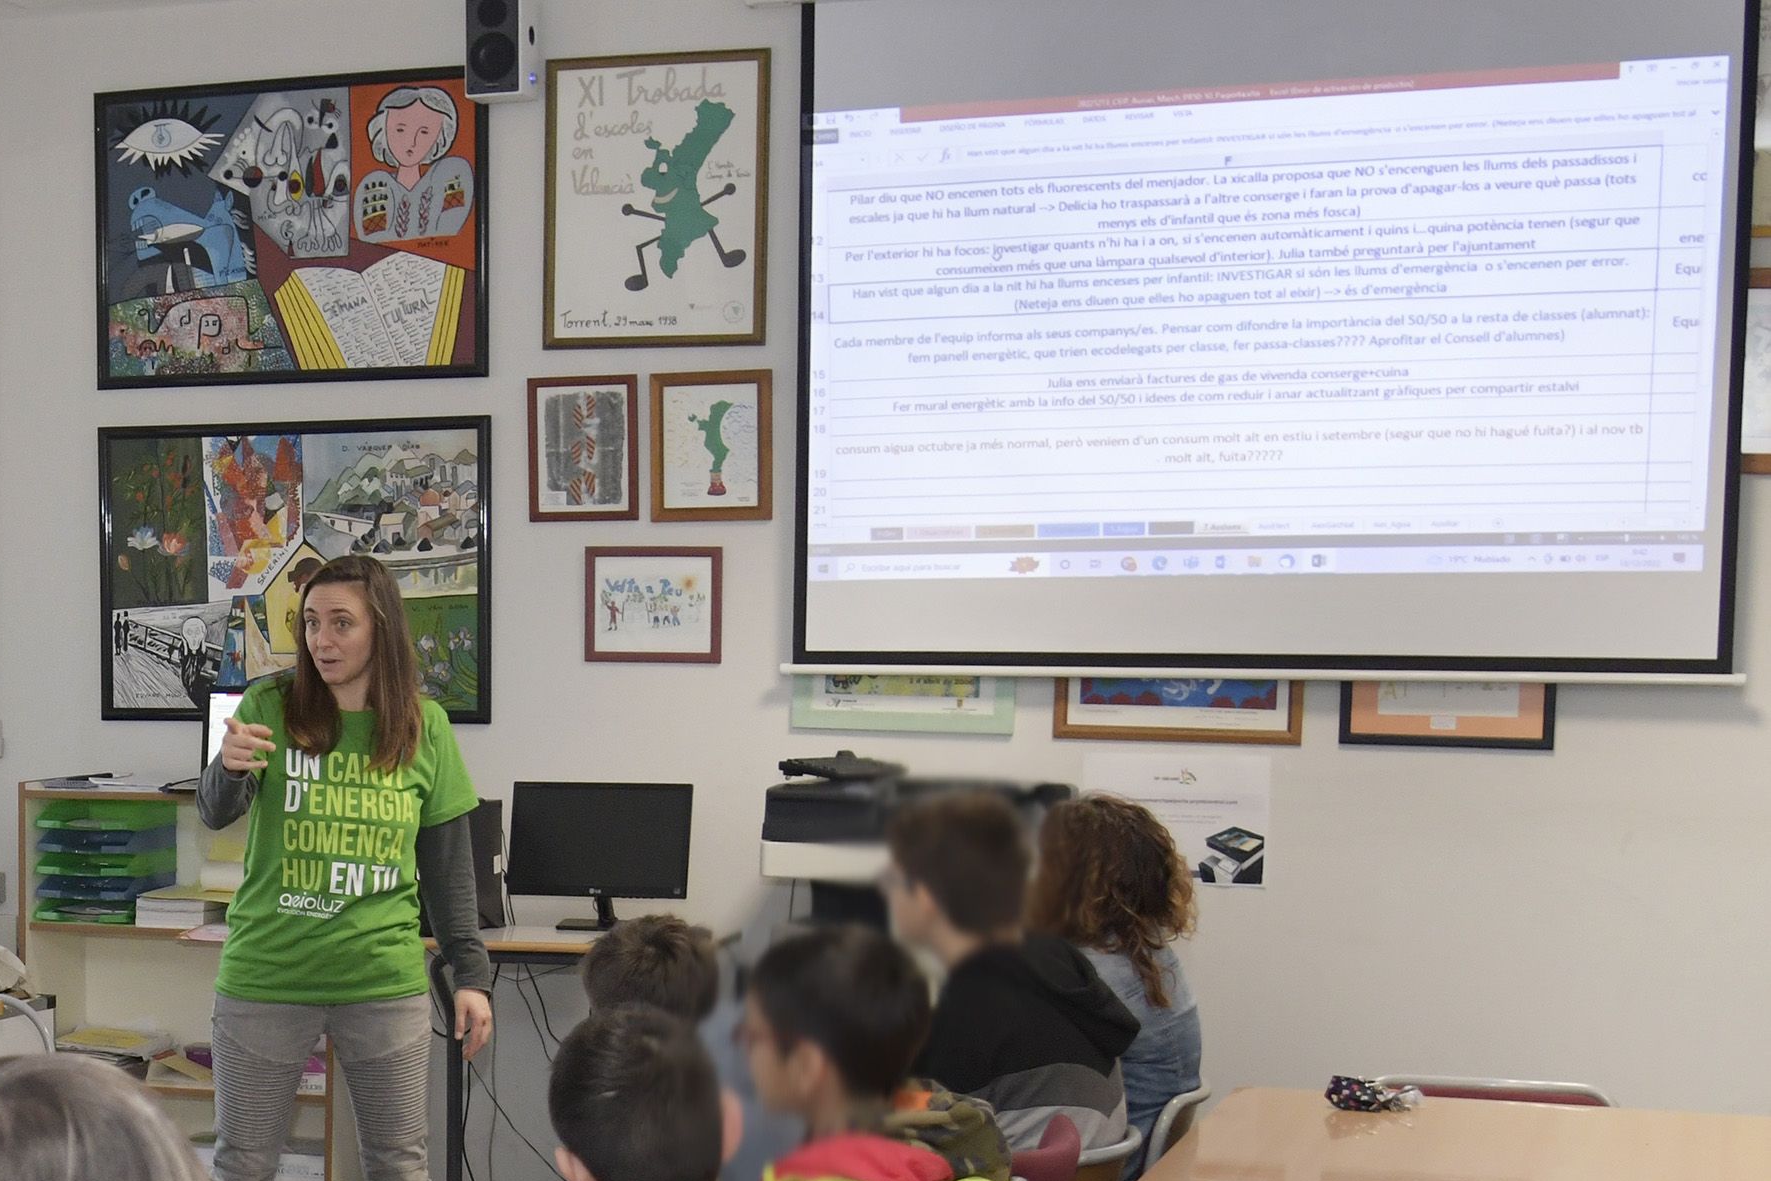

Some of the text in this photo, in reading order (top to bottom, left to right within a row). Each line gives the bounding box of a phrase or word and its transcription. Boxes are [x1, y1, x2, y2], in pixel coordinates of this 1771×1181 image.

[577, 67, 727, 107] XI Trobada
[573, 146, 594, 161] en
[850, 193, 875, 204] Pilar
[878, 191, 897, 203] diu
[899, 192, 922, 204] que
[925, 189, 945, 200] NO
[947, 188, 998, 199] encenen
[1000, 185, 1025, 196] tots
[1027, 183, 1044, 194] els
[1047, 179, 1121, 193] fluorescents
[1124, 178, 1143, 189] del
[1213, 173, 1227, 184] La
[1272, 171, 1324, 184] proposa
[1326, 169, 1351, 181] que
[1354, 166, 1375, 177] NO
[1462, 160, 1480, 172] les
[1483, 159, 1518, 170] llums
[1521, 157, 1548, 169] dels
[1551, 153, 1629, 170] passadissos
[849, 211, 890, 223] escales
[893, 210, 904, 223] ja
[906, 211, 929, 223] que
[932, 207, 943, 218] hi
[946, 206, 961, 218] ha
[963, 205, 989, 217] llum
[992, 202, 1036, 215] natural
[1101, 198, 1117, 209] ho
[1119, 194, 1190, 211] traspassarà
[1242, 191, 1300, 204] conserge
[1309, 187, 1343, 198] faran
[1346, 186, 1357, 197] la
[1360, 186, 1397, 199] prova
[1494, 181, 1532, 190] veure
[1535, 177, 1561, 191] què
[1563, 178, 1601, 190] passa
[1097, 218, 1137, 230] menys
[1140, 214, 1156, 225] els
[1216, 213, 1241, 224] que
[1244, 210, 1257, 220] és
[1261, 210, 1290, 220] zona
[1293, 207, 1319, 218] més
[845, 249, 864, 260] Per
[922, 246, 933, 256] hi
[936, 245, 951, 256] ha
[1053, 238, 1095, 253] quants
[1123, 236, 1139, 247] ha
[1182, 233, 1191, 244] si
[1260, 225, 1364, 240] automàticament
[1374, 223, 1409, 238] quins
[1467, 219, 1524, 234] potència
[1527, 218, 1566, 229] tenen
[1614, 216, 1640, 228] que
[935, 261, 1014, 275] consumeixen
[1016, 260, 1041, 271] més
[1043, 261, 1067, 273] que
[1069, 260, 1092, 269] una
[1095, 255, 1145, 270] làmpara
[1148, 252, 1206, 268] qualsevol
[1278, 248, 1305, 259] Julia
[1308, 246, 1349, 258] també
[1352, 243, 1424, 259] preguntarà
[1427, 245, 1449, 256] per
[322, 288, 437, 328] SETMANA CULTURAL
[1061, 298, 1082, 307] ens
[1084, 294, 1119, 306] diuen
[1122, 295, 1145, 307] que
[1148, 292, 1175, 303] elles
[1178, 291, 1194, 302] ho
[1197, 291, 1250, 304] apaguen
[1253, 289, 1272, 299] tot
[1275, 287, 1286, 298] al
[1344, 285, 1358, 296] és
[285, 748, 321, 781] UN
[284, 780, 415, 823] D'ENERGIA
[283, 819, 404, 866] COMENÇA
[281, 858, 400, 897] HUI EN TU
[279, 891, 346, 913] aeioluz
